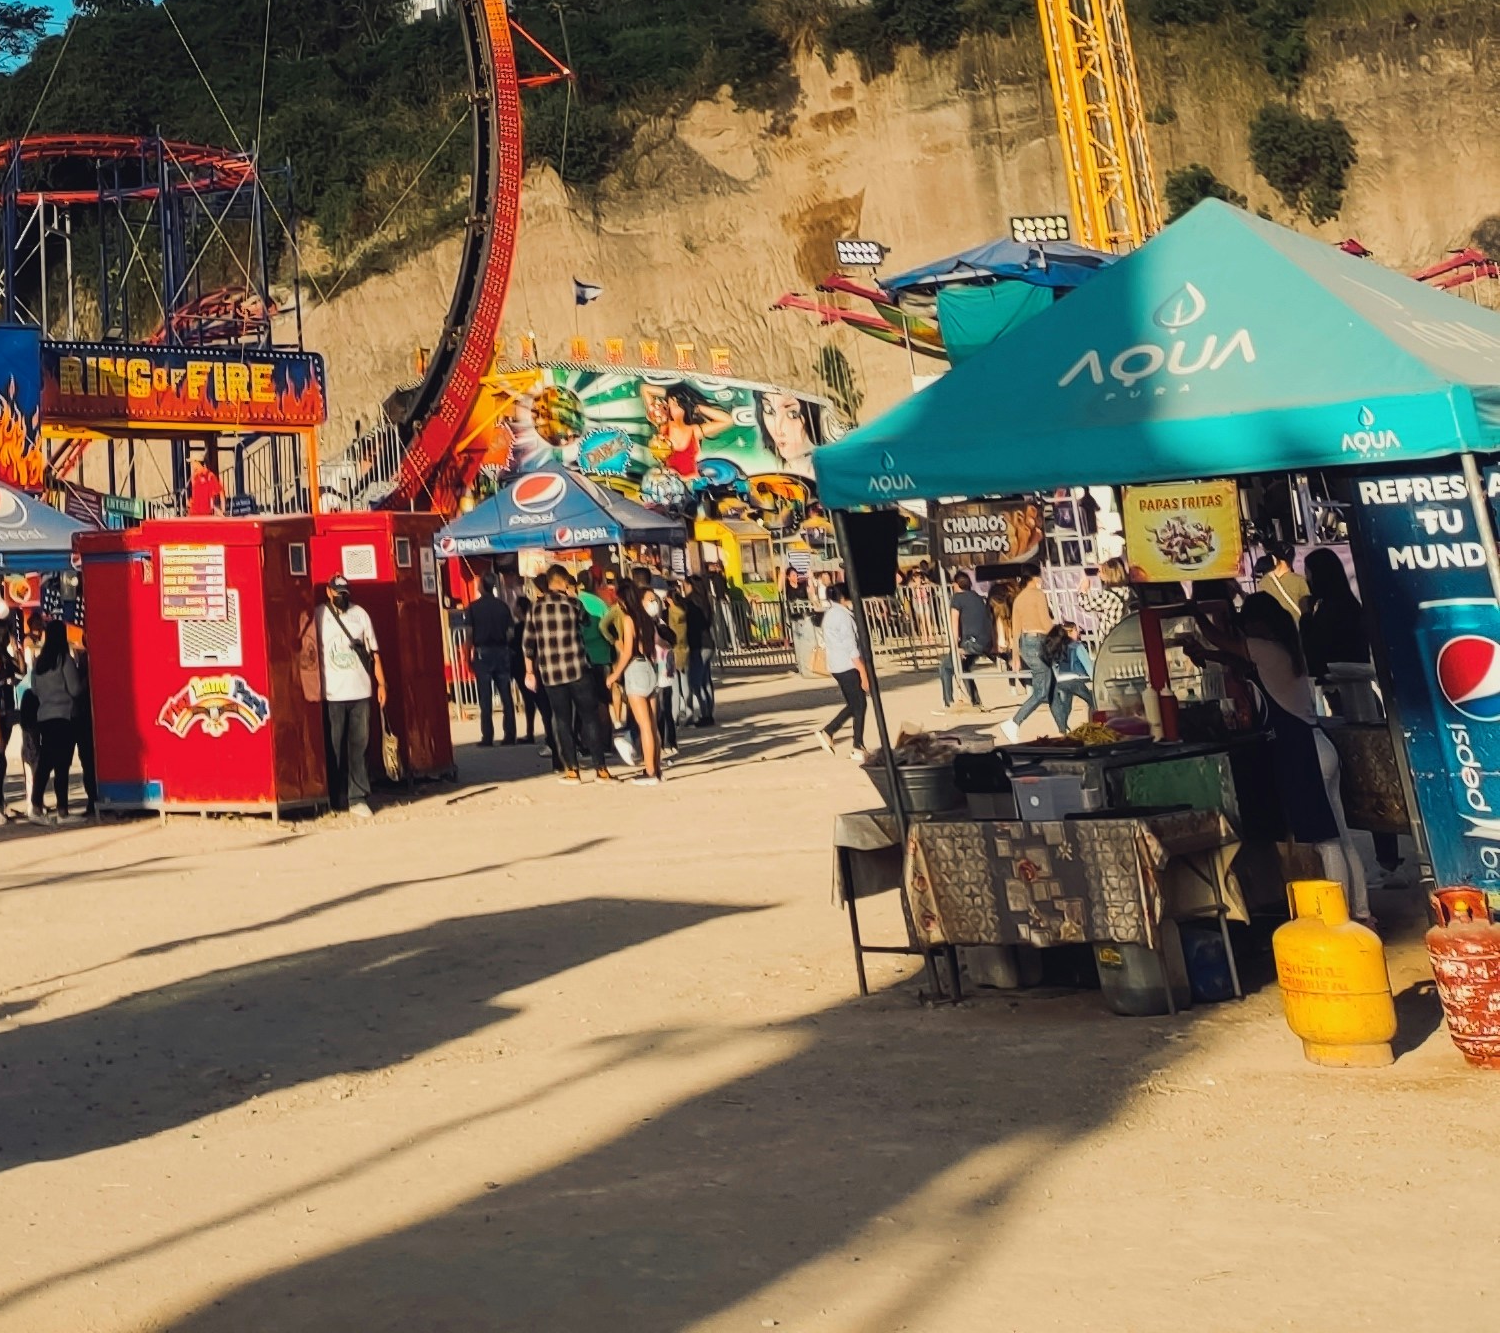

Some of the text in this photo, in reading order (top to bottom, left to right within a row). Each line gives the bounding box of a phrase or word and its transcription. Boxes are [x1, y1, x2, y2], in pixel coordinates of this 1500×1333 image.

[1057, 328, 1257, 388] AQUA
[58, 356, 151, 399] RING
[186, 360, 276, 403] FIRE
[1104, 383, 1191, 402] PURA
[1341, 429, 1402, 454] AQUA
[867, 472, 917, 494] AQUA
[1139, 494, 1223, 511] PAPAS FRITAS
[943, 514, 1008, 534] CHURROS
[1415, 509, 1464, 535] TU
[457, 535, 491, 552] pepsi
[572, 526, 610, 542] pepsi
[943, 534, 1010, 555] RELLENOS
[1387, 541, 1488, 571] MUND
[1445, 722, 1493, 813] pepsi
